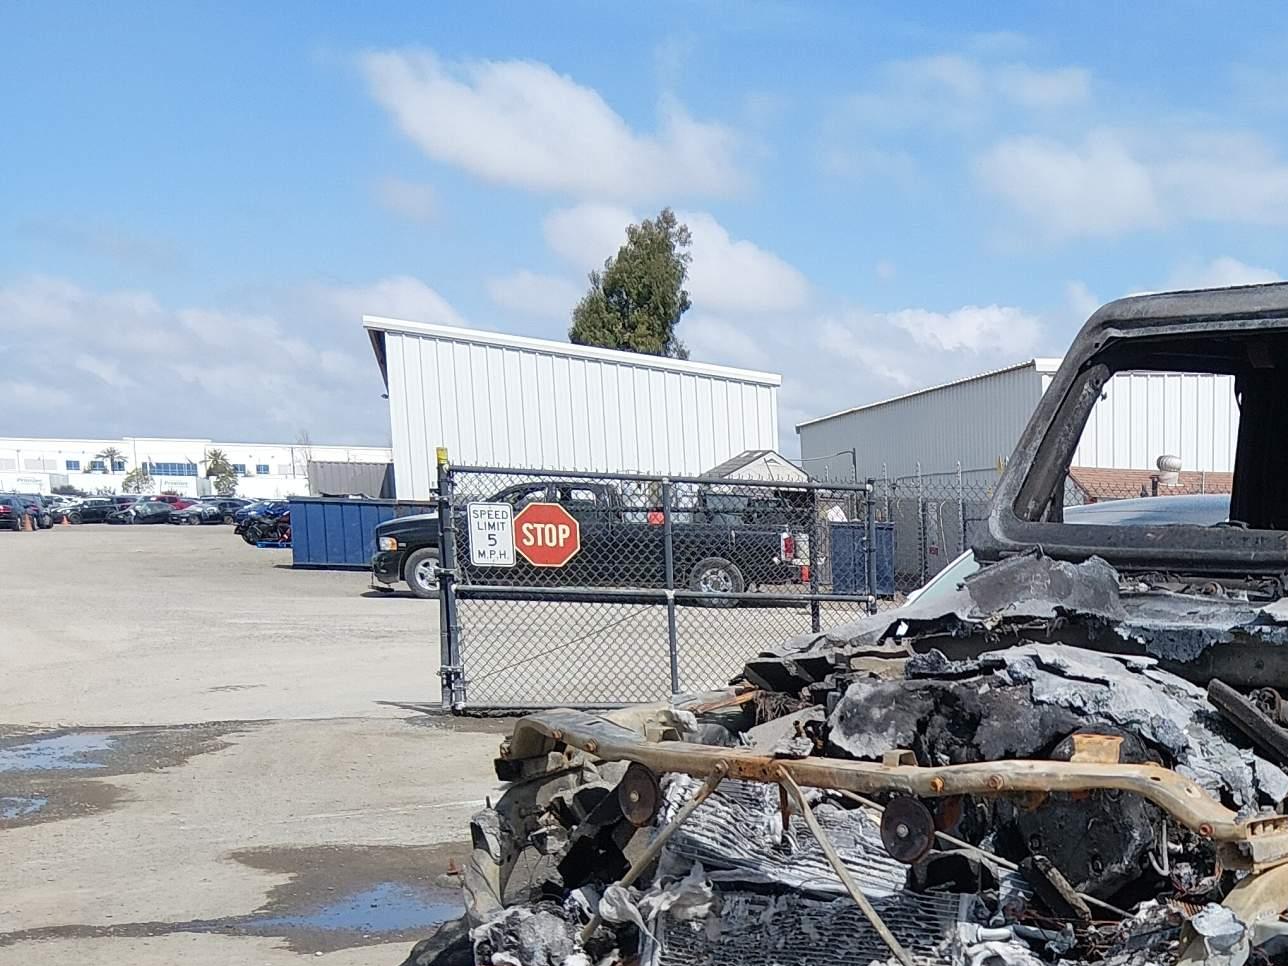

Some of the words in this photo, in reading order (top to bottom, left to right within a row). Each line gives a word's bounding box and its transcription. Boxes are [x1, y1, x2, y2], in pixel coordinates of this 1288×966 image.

[472, 509, 509, 520] SPEED
[477, 521, 505, 531] LIMIT
[487, 533, 497, 547] 5
[521, 523, 571, 548] STOP
[478, 549, 510, 560] M.P.H.
